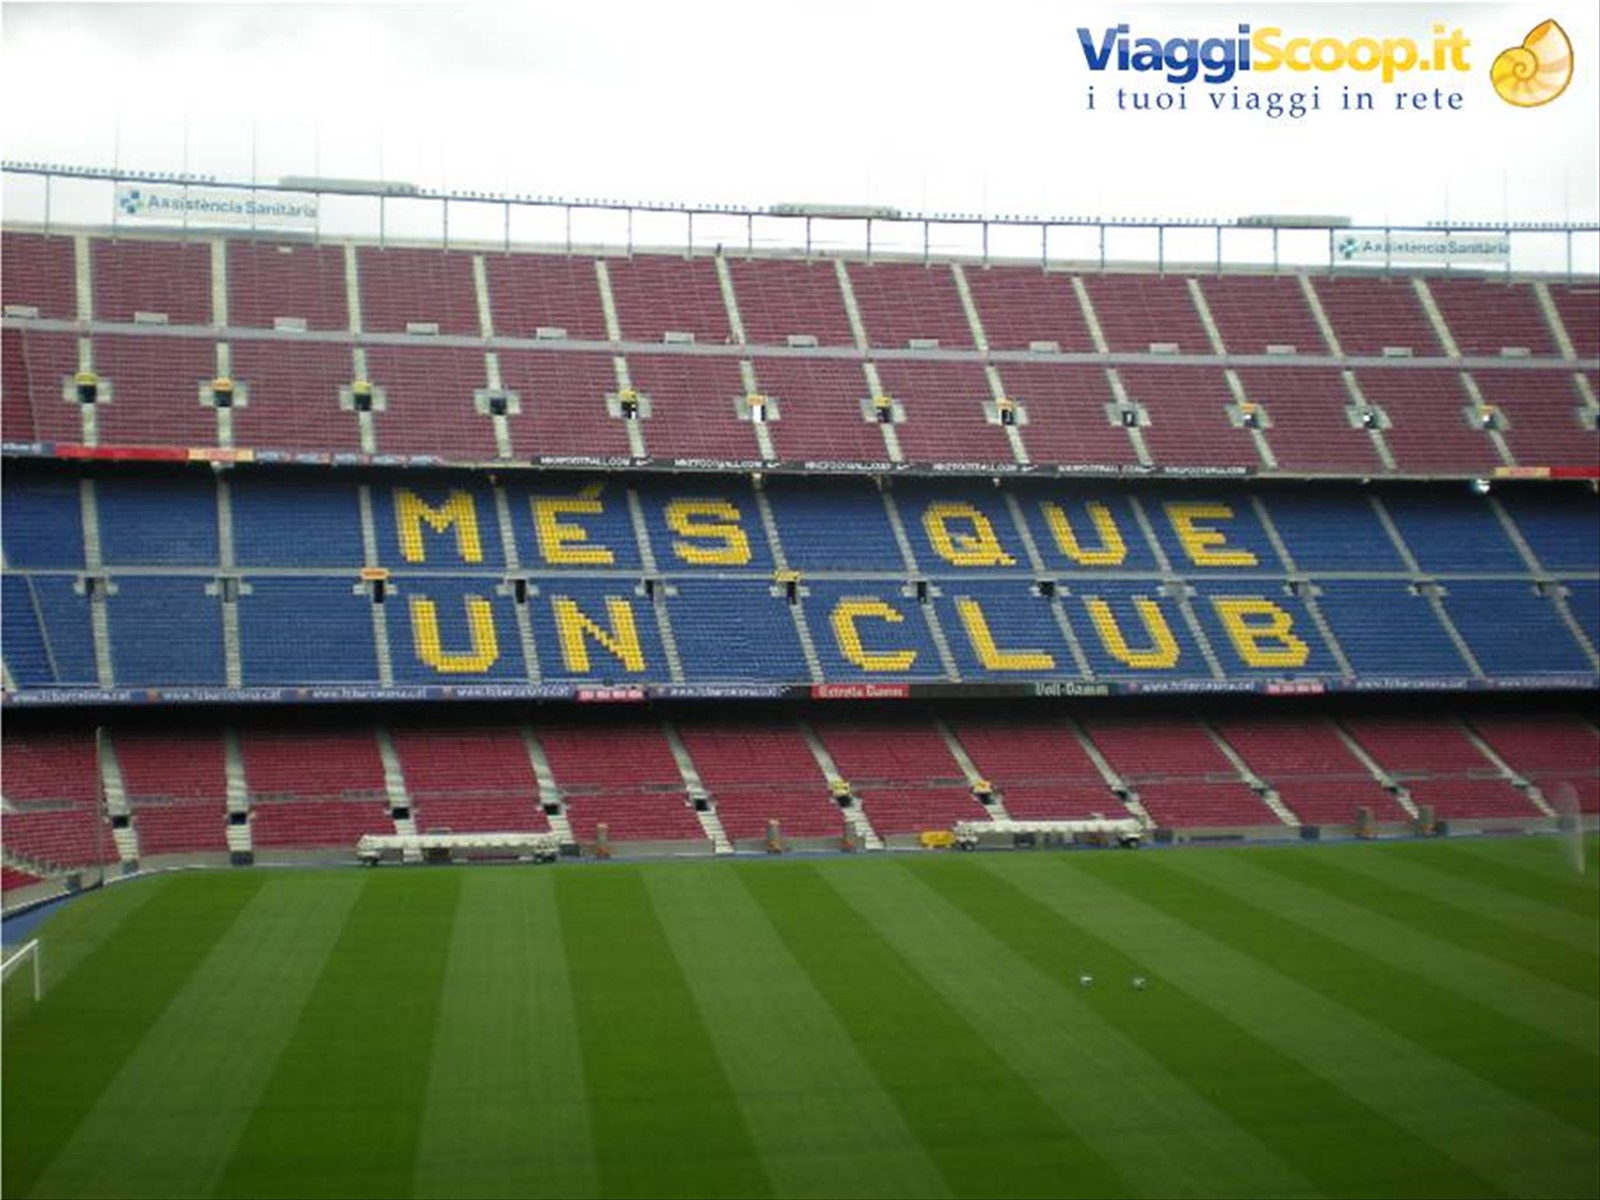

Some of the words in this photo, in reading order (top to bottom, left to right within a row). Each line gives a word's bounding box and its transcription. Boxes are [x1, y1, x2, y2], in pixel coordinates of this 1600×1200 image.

[394, 483, 750, 567] MÉS
[923, 500, 1258, 568] QUE
[408, 596, 646, 674] UN
[829, 598, 1310, 671] CLUB
